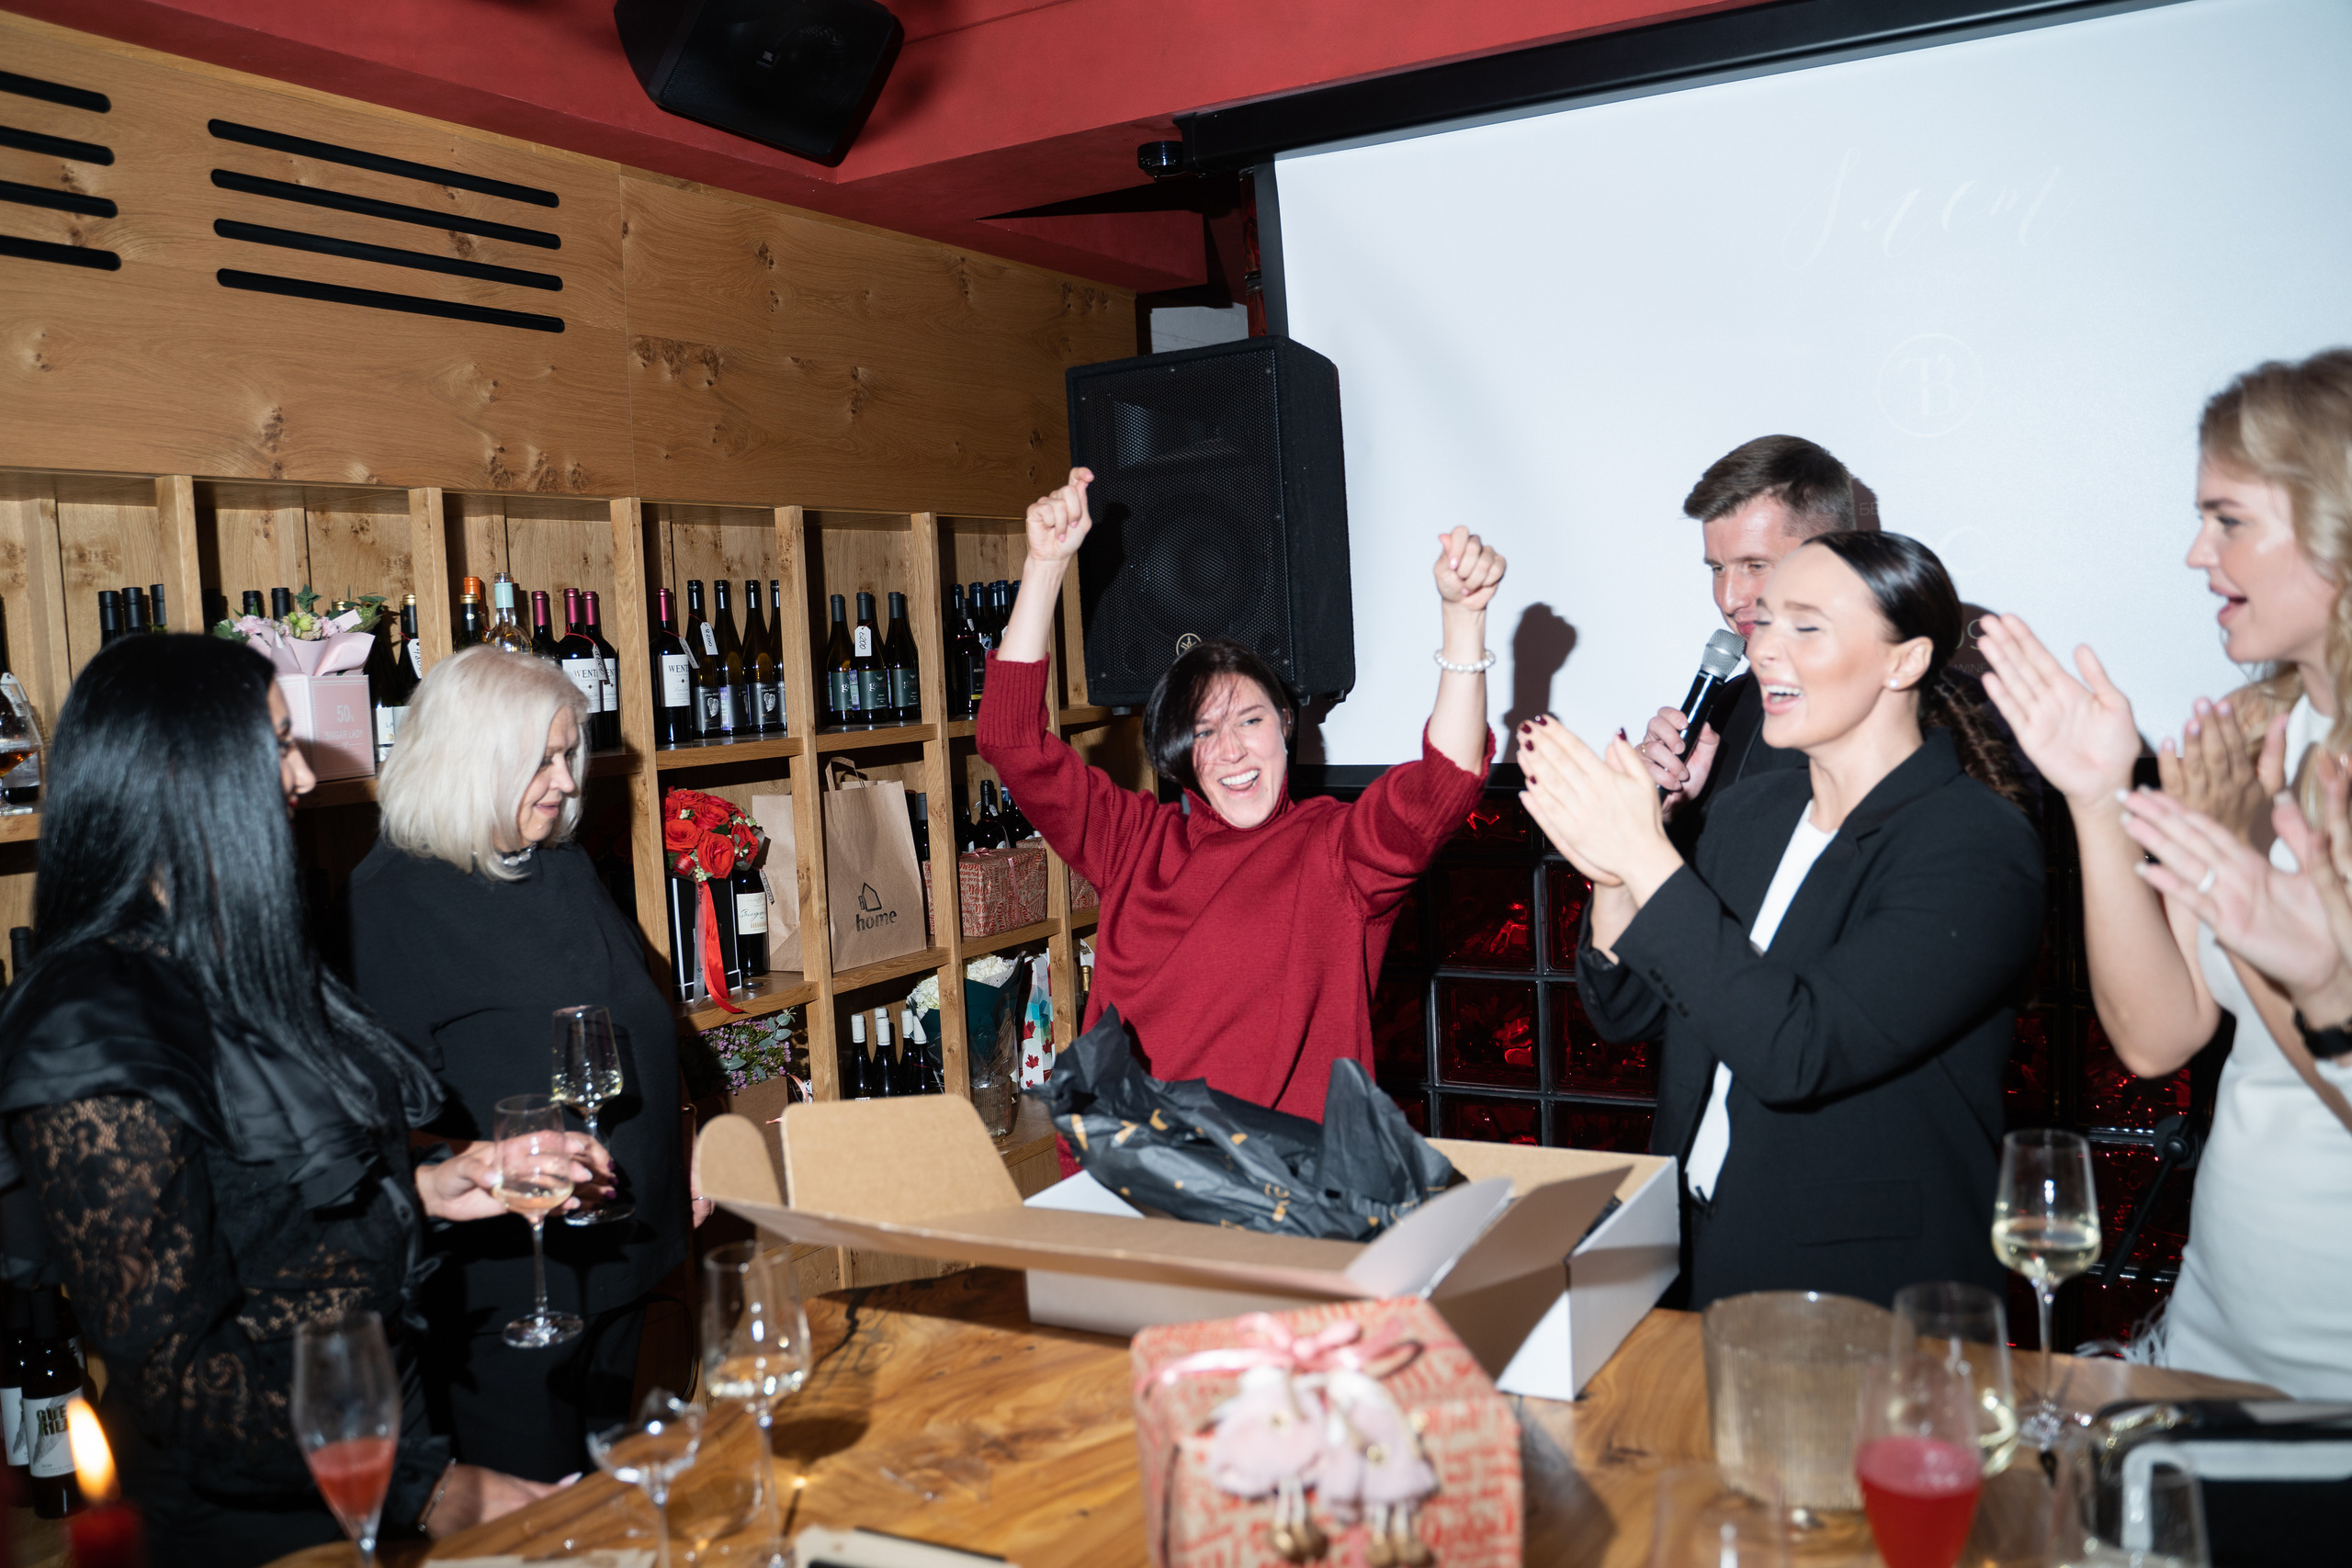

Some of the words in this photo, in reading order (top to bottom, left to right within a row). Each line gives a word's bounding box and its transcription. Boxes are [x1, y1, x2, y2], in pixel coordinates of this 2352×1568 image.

[573, 669, 599, 678] WENT
[324, 729, 347, 741] SUGAR
[349, 728, 364, 739] LADY
[855, 910, 898, 932] home
